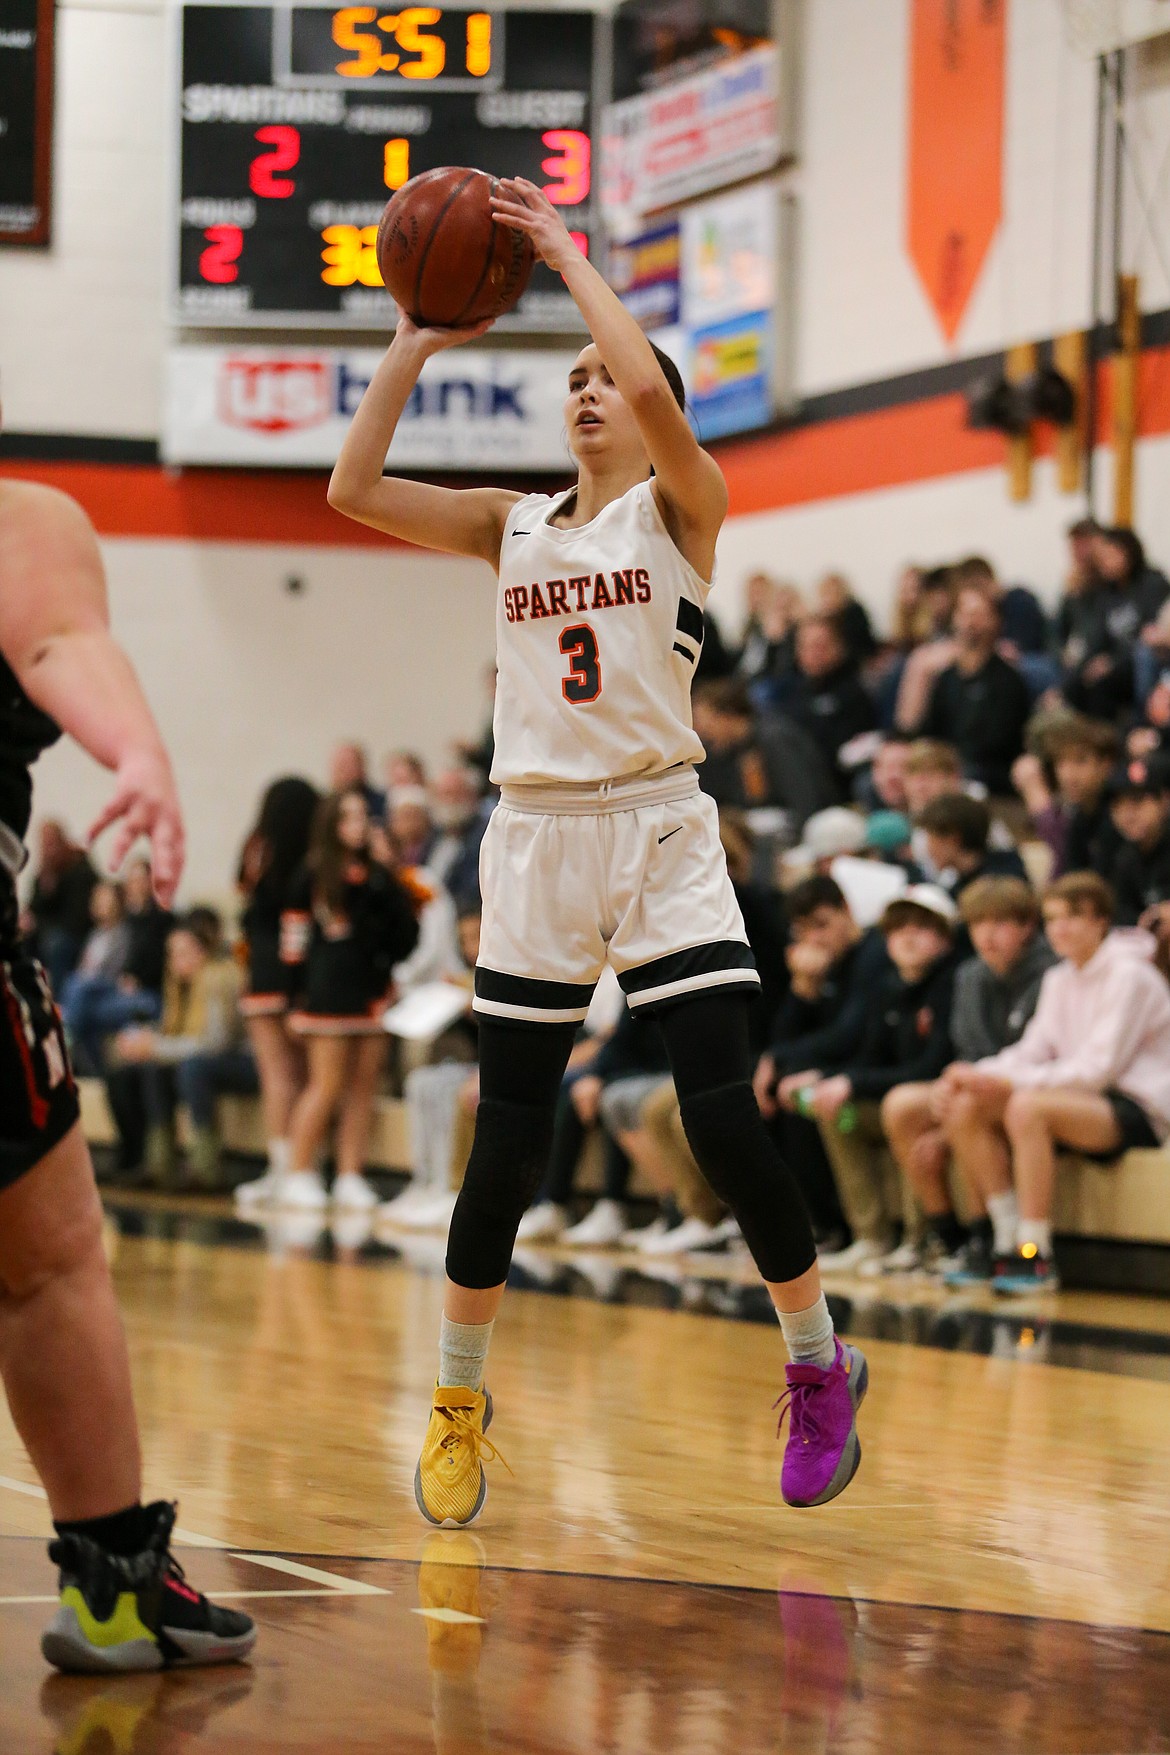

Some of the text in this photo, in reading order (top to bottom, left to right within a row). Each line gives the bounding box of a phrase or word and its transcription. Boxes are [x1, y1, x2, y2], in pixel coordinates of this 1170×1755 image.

[333, 6, 491, 79] 5:51
[249, 125, 300, 198] 2
[384, 138, 410, 190] 1
[541, 130, 591, 204] 3
[200, 223, 244, 284] 2
[504, 568, 652, 624] SPARTANS
[558, 622, 602, 705] 3
